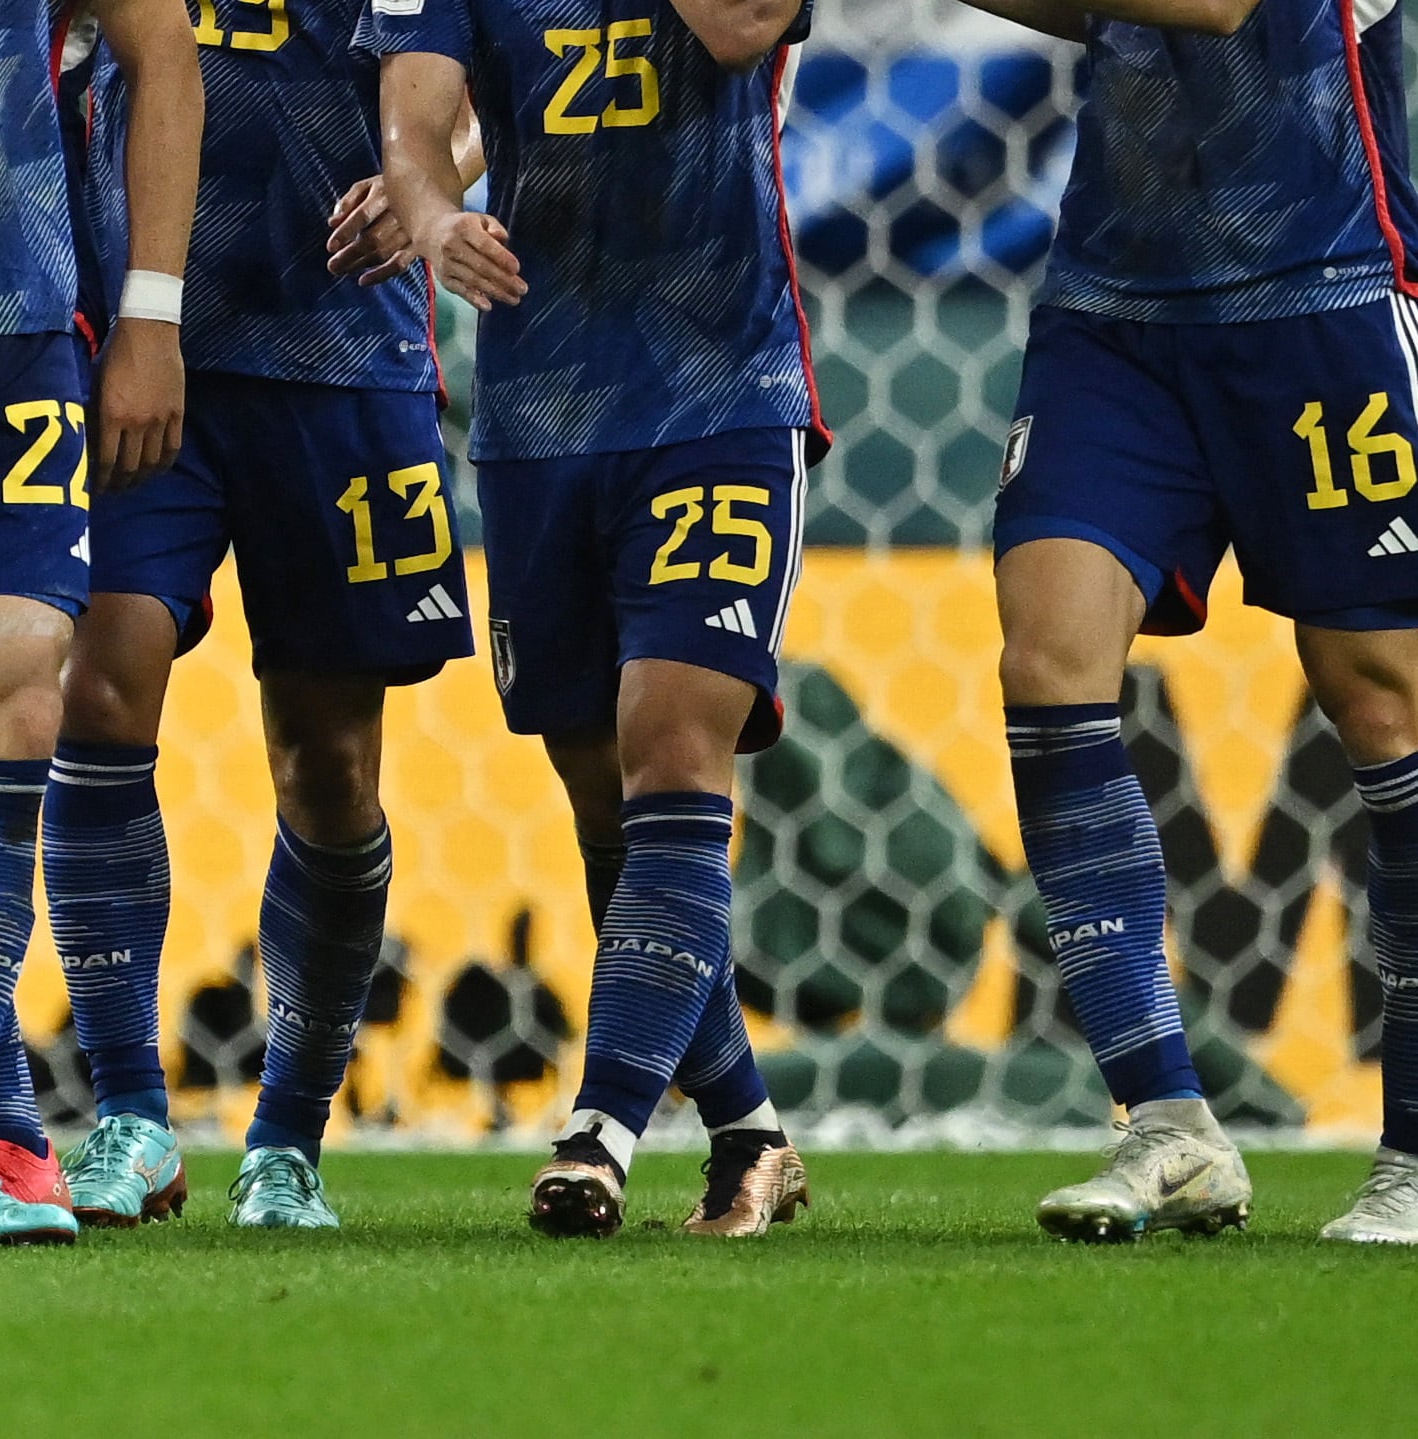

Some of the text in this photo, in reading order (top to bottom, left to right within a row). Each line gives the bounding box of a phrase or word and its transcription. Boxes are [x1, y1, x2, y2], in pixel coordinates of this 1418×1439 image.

[544, 18, 661, 136] 25
[1293, 392, 1418, 511] 16
[336, 462, 453, 584] 13
[649, 484, 773, 587] 25
[56, 949, 132, 970] PAN
[602, 938, 714, 978] JAPAN
[1048, 916, 1126, 954] PAN
